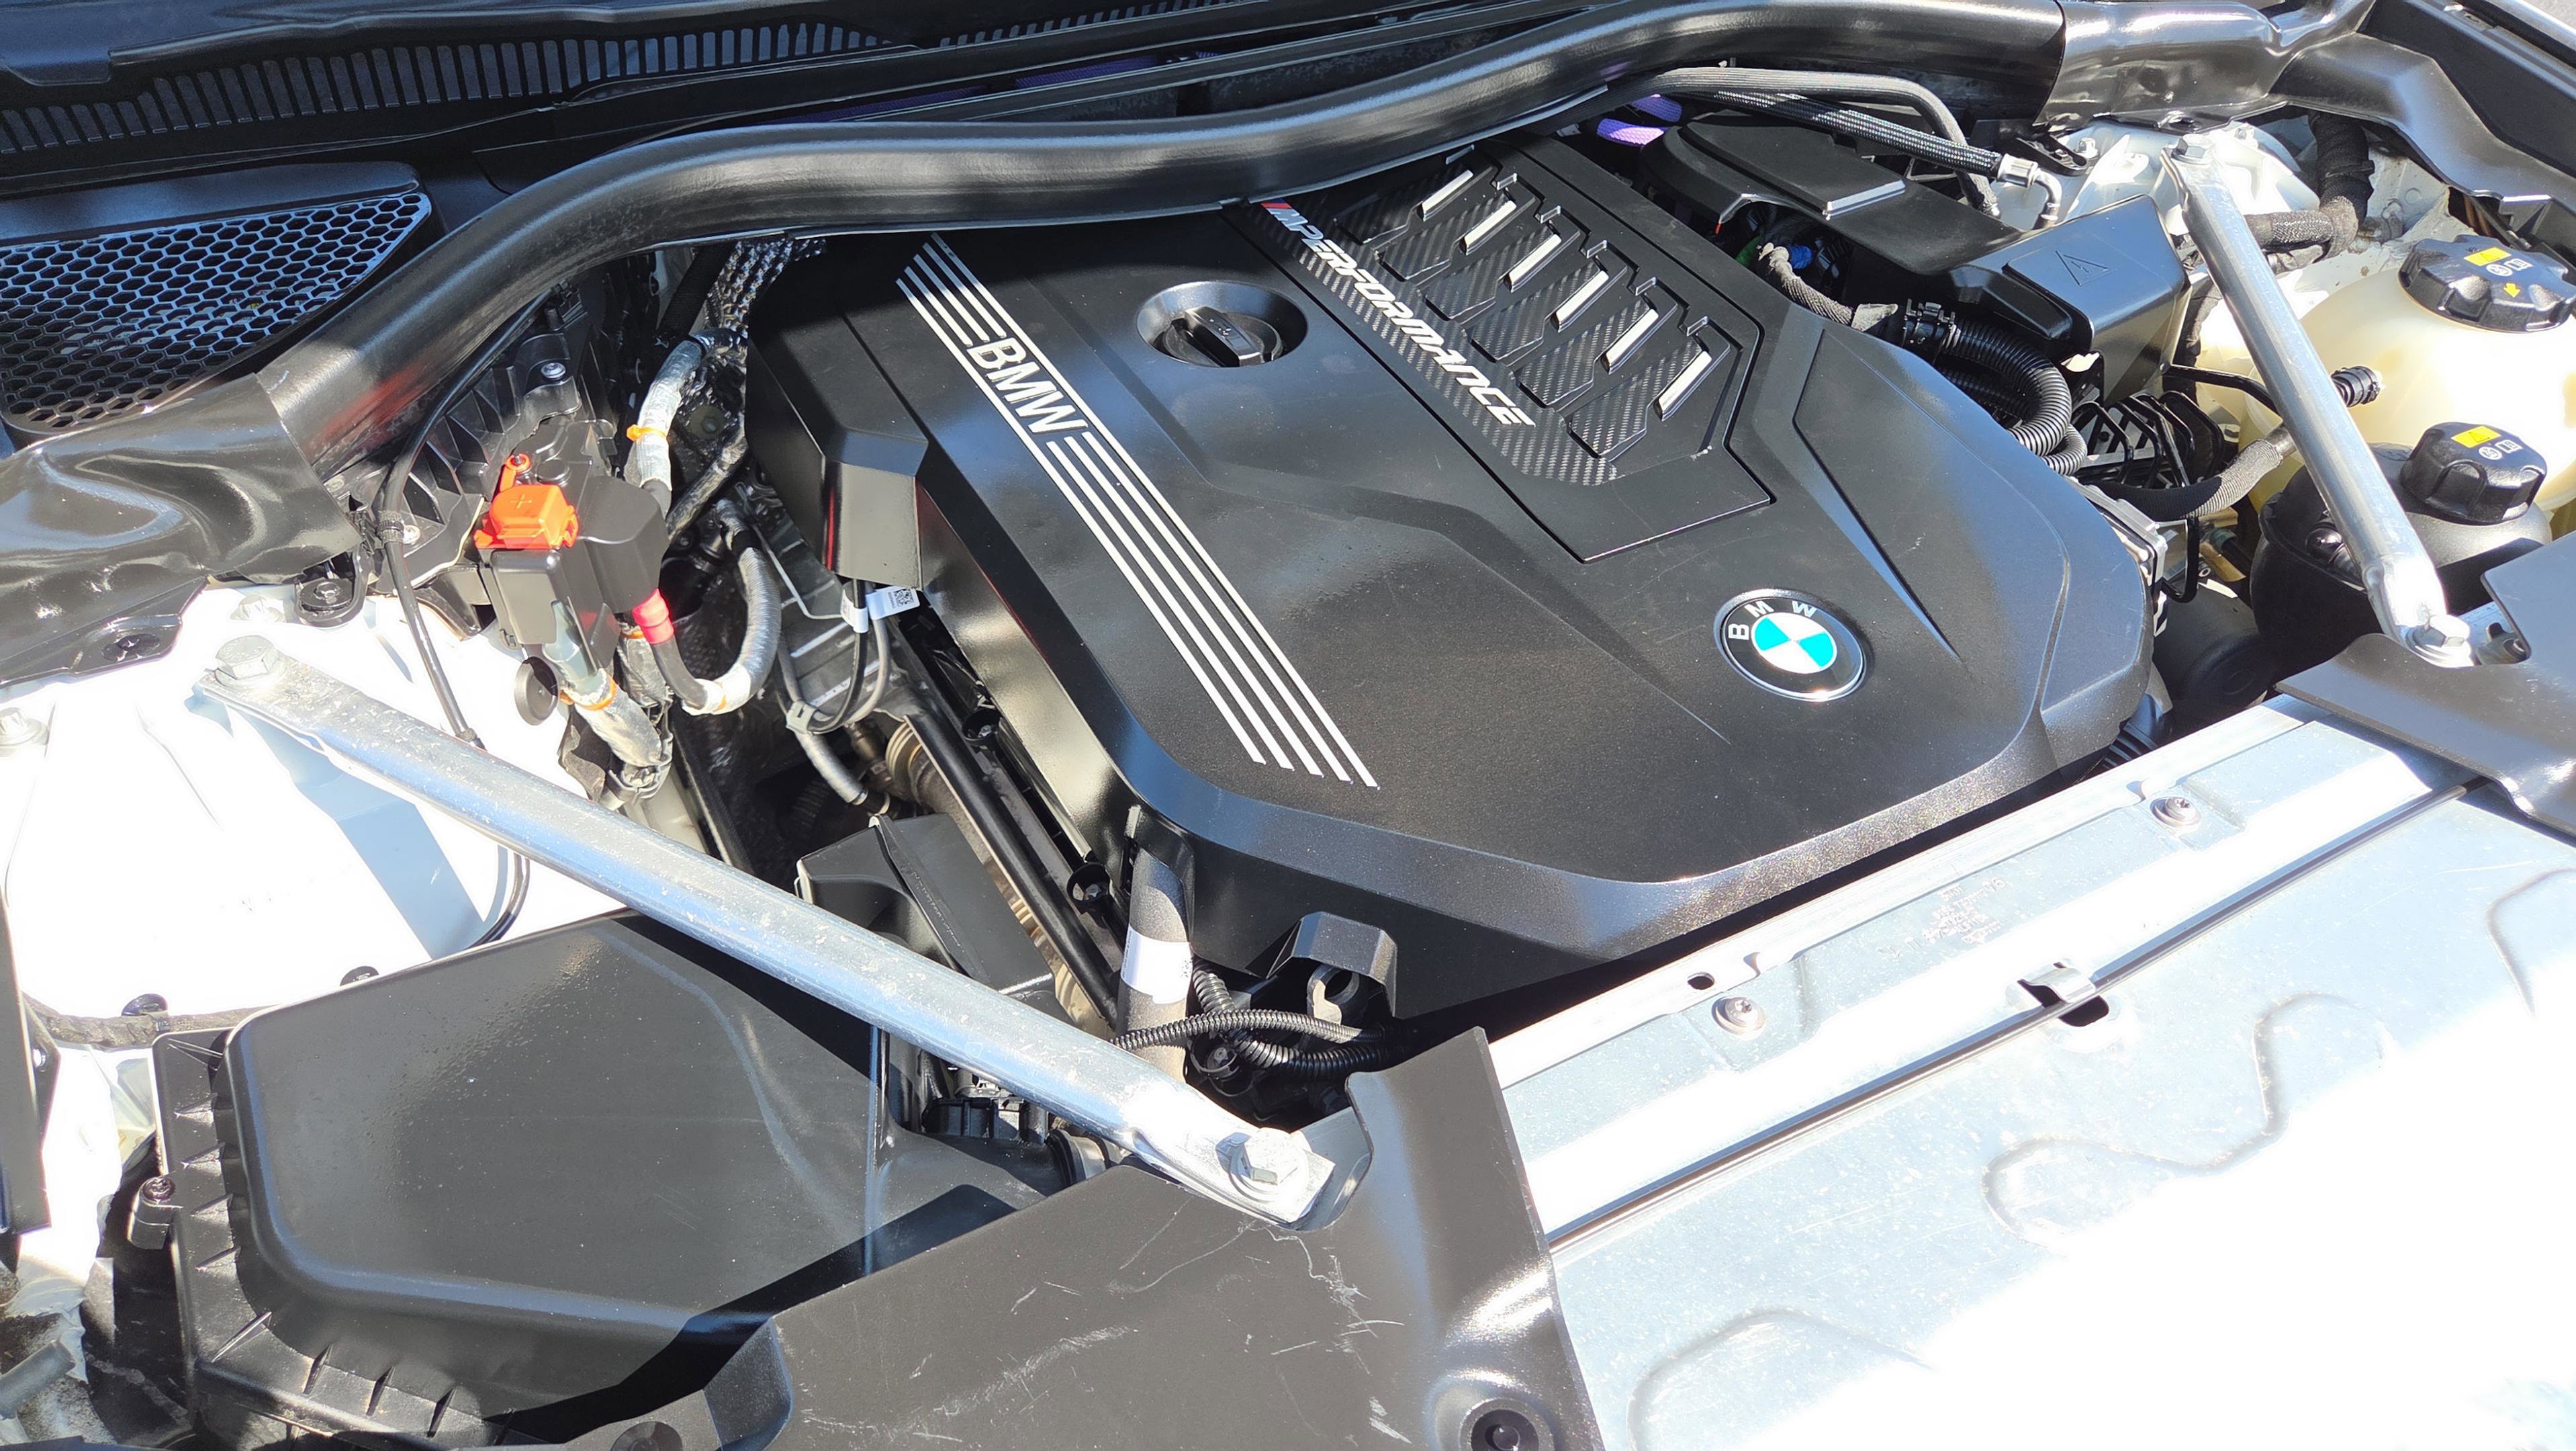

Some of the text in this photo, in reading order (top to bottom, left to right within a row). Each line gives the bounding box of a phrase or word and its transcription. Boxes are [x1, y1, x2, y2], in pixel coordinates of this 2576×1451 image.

[1286, 224, 1536, 427] PERFORMANCE
[966, 337, 1089, 433] BMW
[1728, 600, 1817, 641] BMW
